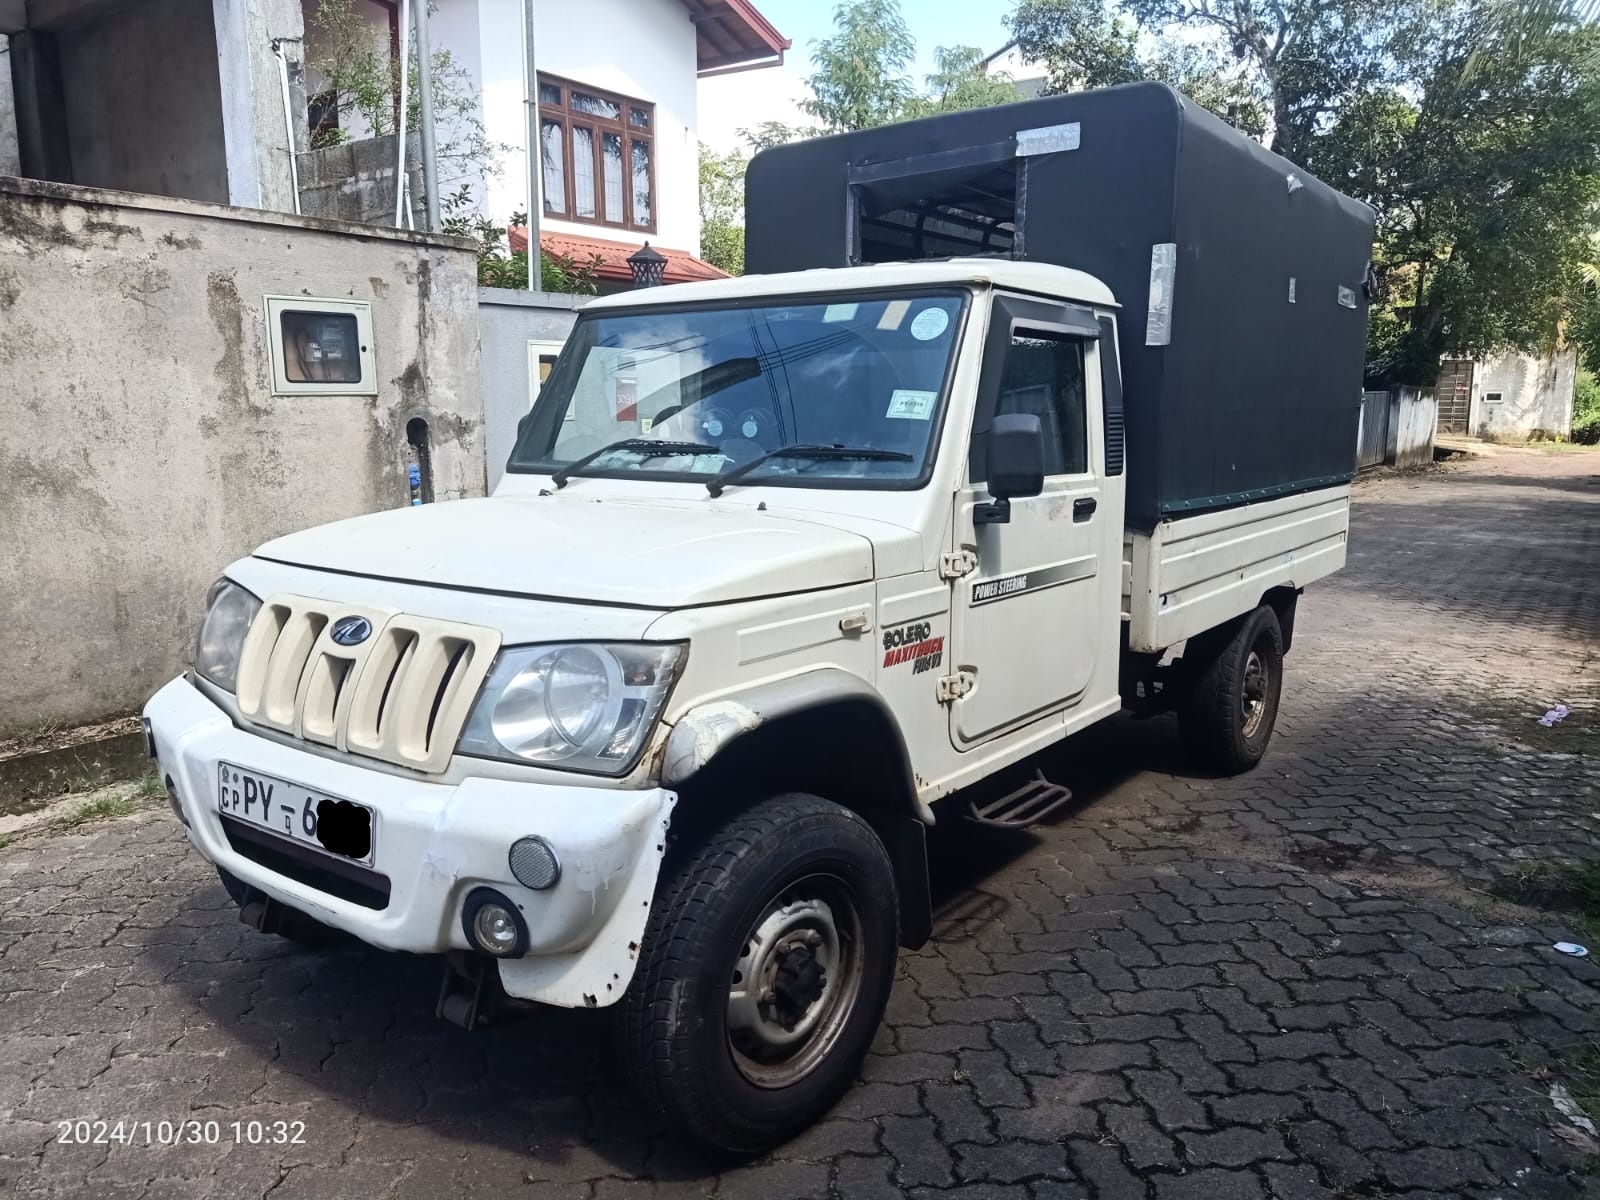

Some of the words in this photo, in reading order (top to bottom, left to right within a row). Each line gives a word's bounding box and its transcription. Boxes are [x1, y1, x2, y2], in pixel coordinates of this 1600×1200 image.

[974, 581, 999, 600] POWER
[999, 575, 1027, 594] STEERING
[883, 622, 931, 650] BOLERO
[883, 636, 945, 668] MAXITRUCK
[243, 776, 318, 837] PY-6
